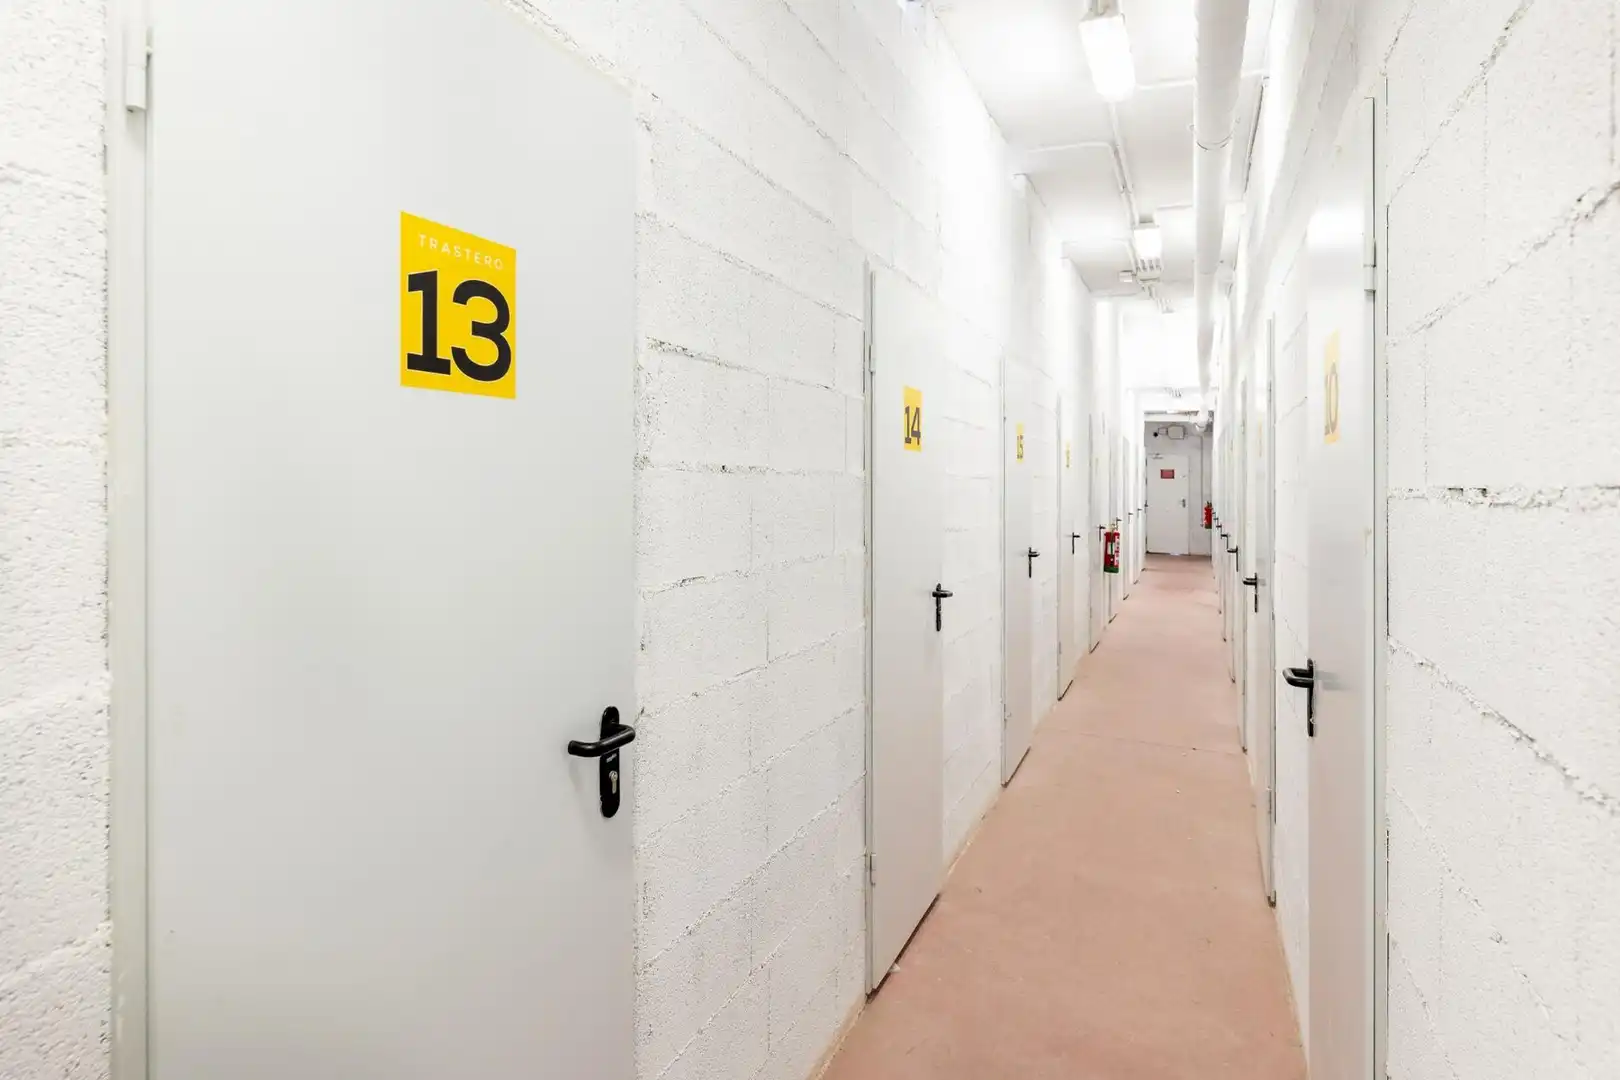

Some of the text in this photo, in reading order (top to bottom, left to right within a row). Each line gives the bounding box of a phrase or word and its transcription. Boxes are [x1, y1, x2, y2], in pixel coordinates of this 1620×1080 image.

[418, 233, 504, 270] TRASTERO
[407, 270, 512, 382] 13
[904, 406, 921, 446] 14
[1323, 362, 1338, 436] 10
